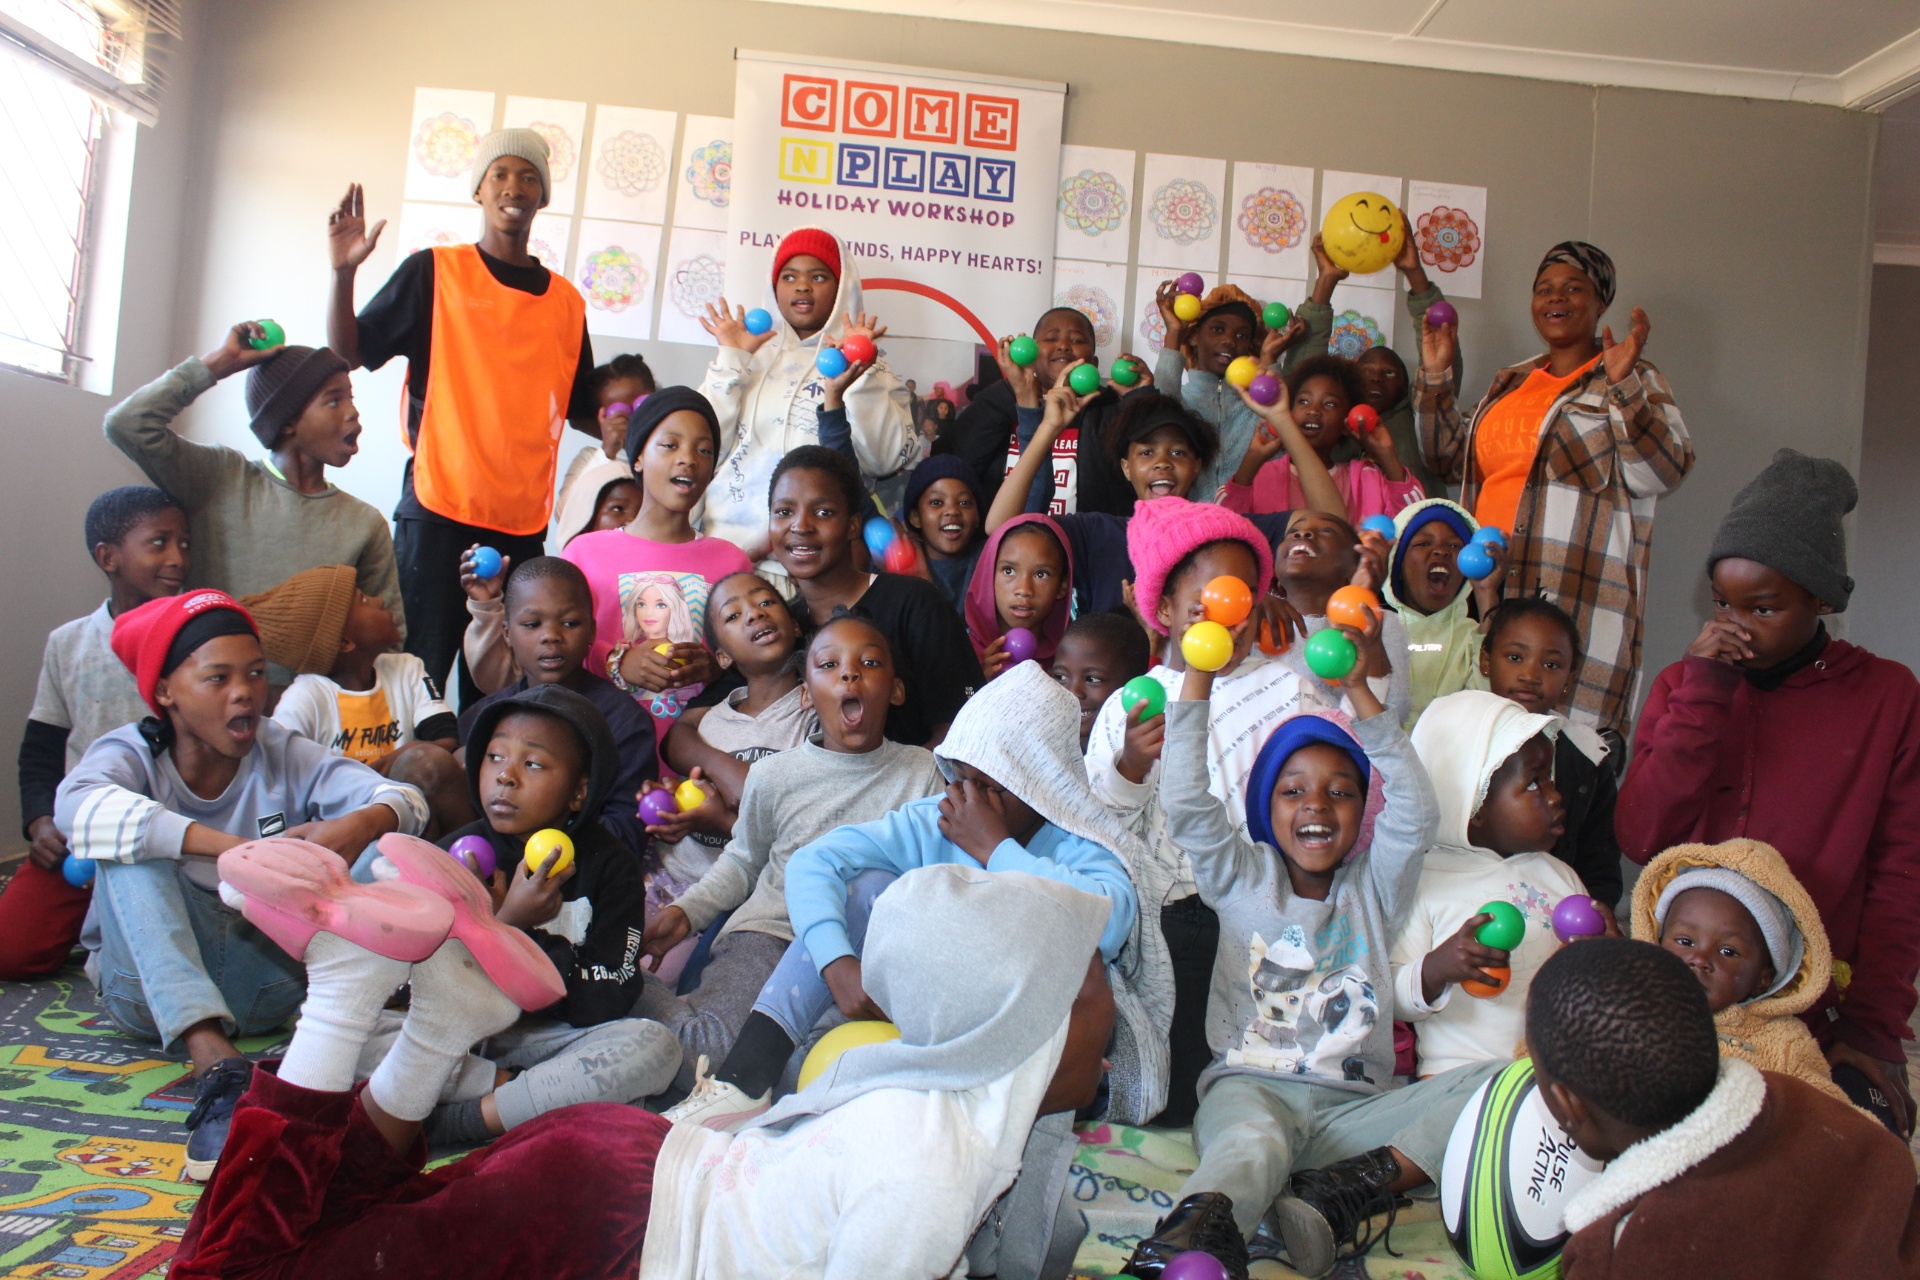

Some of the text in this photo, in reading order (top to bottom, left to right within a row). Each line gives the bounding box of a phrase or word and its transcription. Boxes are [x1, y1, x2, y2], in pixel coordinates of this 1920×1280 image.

[789, 84, 1010, 144] COME
[844, 150, 1010, 195] PLAY
[777, 189, 1015, 228] HOLIDAY WORKSHOP
[739, 231, 780, 248] PLA
[847, 241, 894, 261] INDS,
[901, 246, 961, 265] HAPPY
[967, 253, 1042, 275] HEARTS!
[1053, 438, 1078, 450] LEAG
[330, 727, 357, 751] MY
[703, 835, 722, 845] YOU
[56, 1051, 128, 1065] BUS
[577, 1023, 662, 1075] Micke
[1527, 1125, 1557, 1202] ACTIVE
